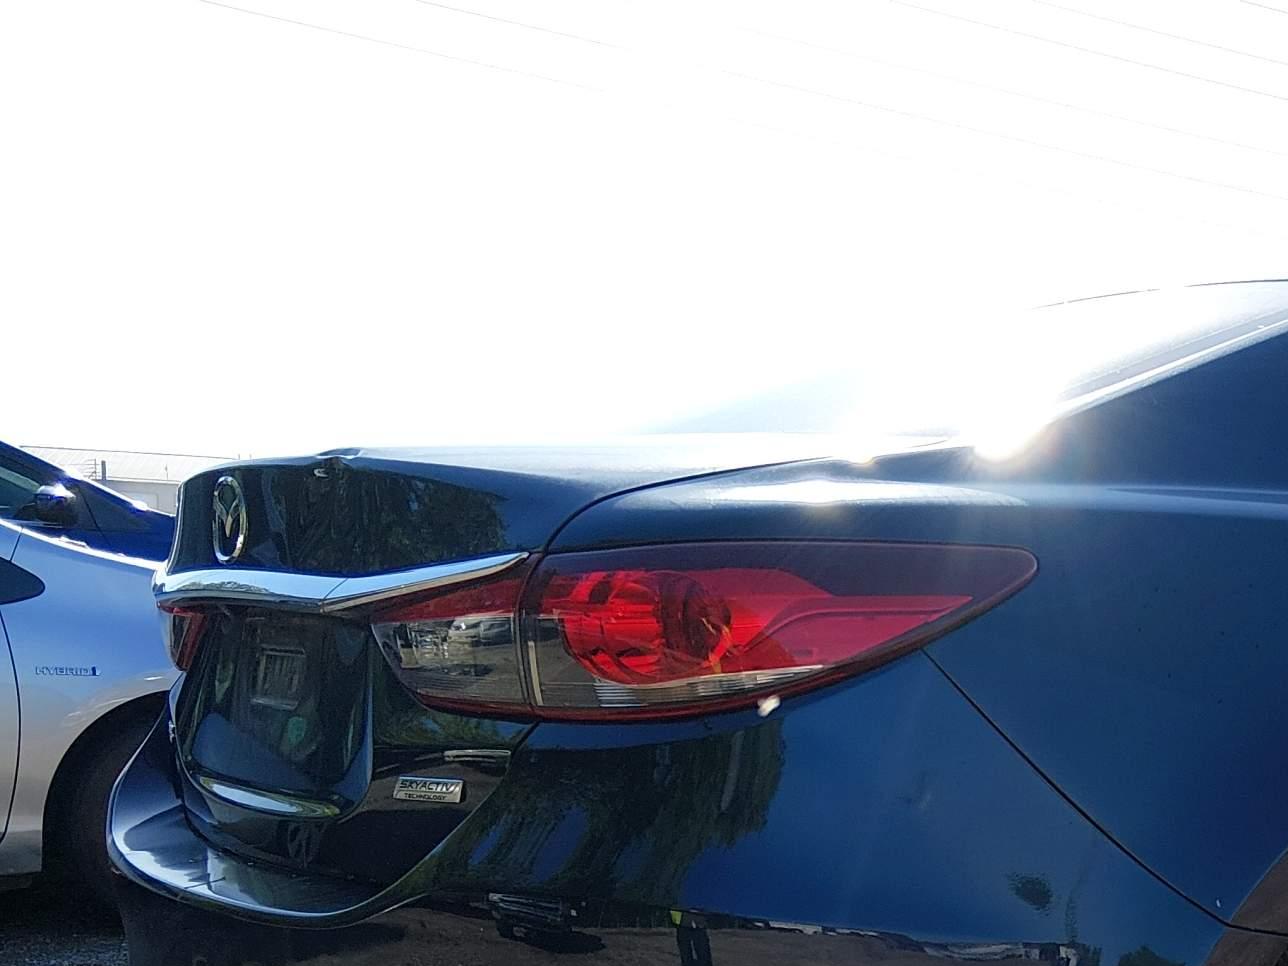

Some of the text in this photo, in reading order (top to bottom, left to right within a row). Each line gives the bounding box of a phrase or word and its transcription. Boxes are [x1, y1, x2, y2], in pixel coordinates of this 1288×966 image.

[35, 666, 91, 676] HYBRID
[399, 780, 458, 792] SKYACTIV
[404, 792, 447, 800] TECHNOLOGY
